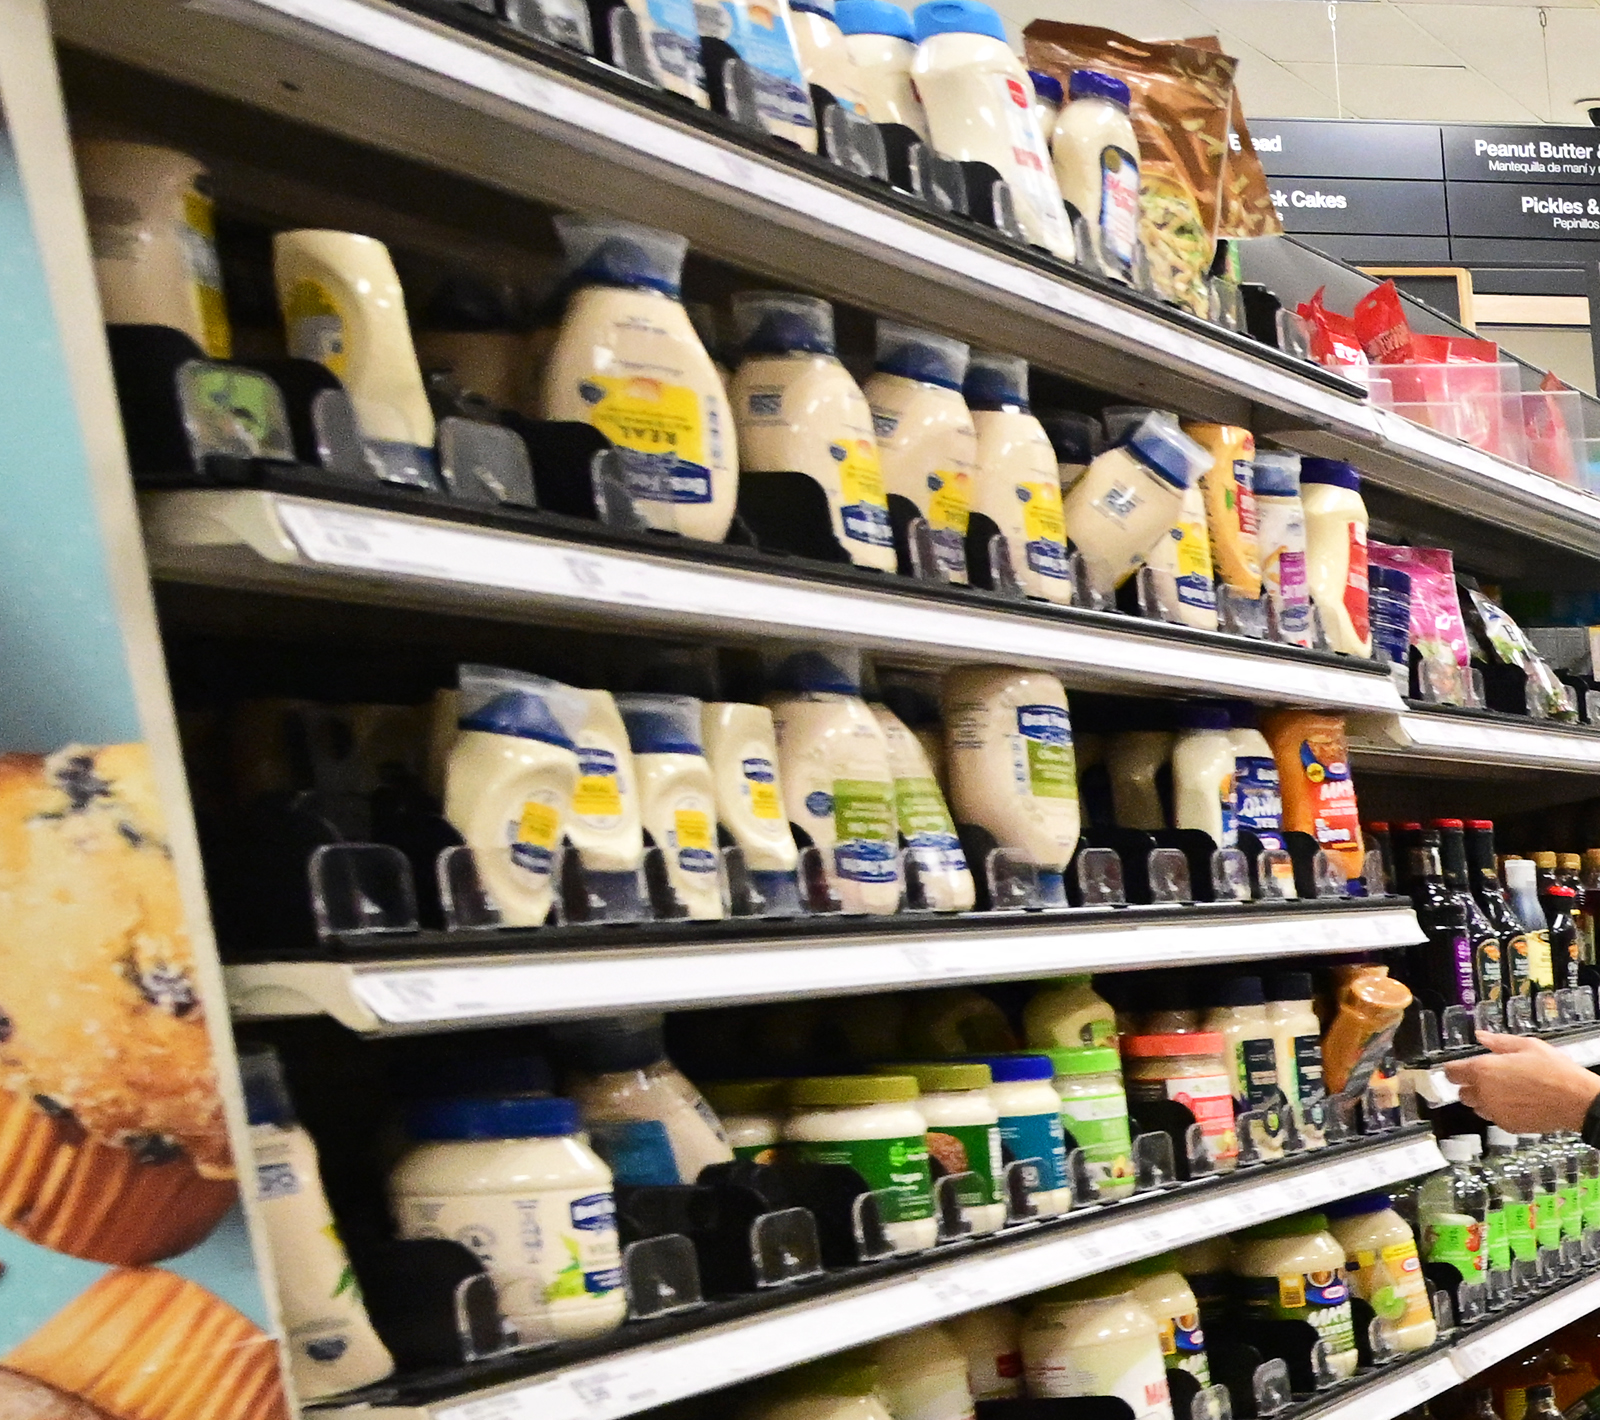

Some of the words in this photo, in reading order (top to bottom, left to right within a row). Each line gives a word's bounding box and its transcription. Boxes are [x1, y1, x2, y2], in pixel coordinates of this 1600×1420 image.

[1475, 139, 1536, 158] Peanut
[1539, 142, 1593, 160] Butter
[1488, 160, 1546, 174] Mantequilla
[1547, 162, 1561, 173] de
[1563, 162, 1588, 173] maní
[1589, 166, 1596, 176] y
[1291, 191, 1347, 208] Cakes
[1521, 196, 1583, 215] Pickles
[1587, 198, 1600, 215] &
[1553, 218, 1600, 231] Pepinillos
